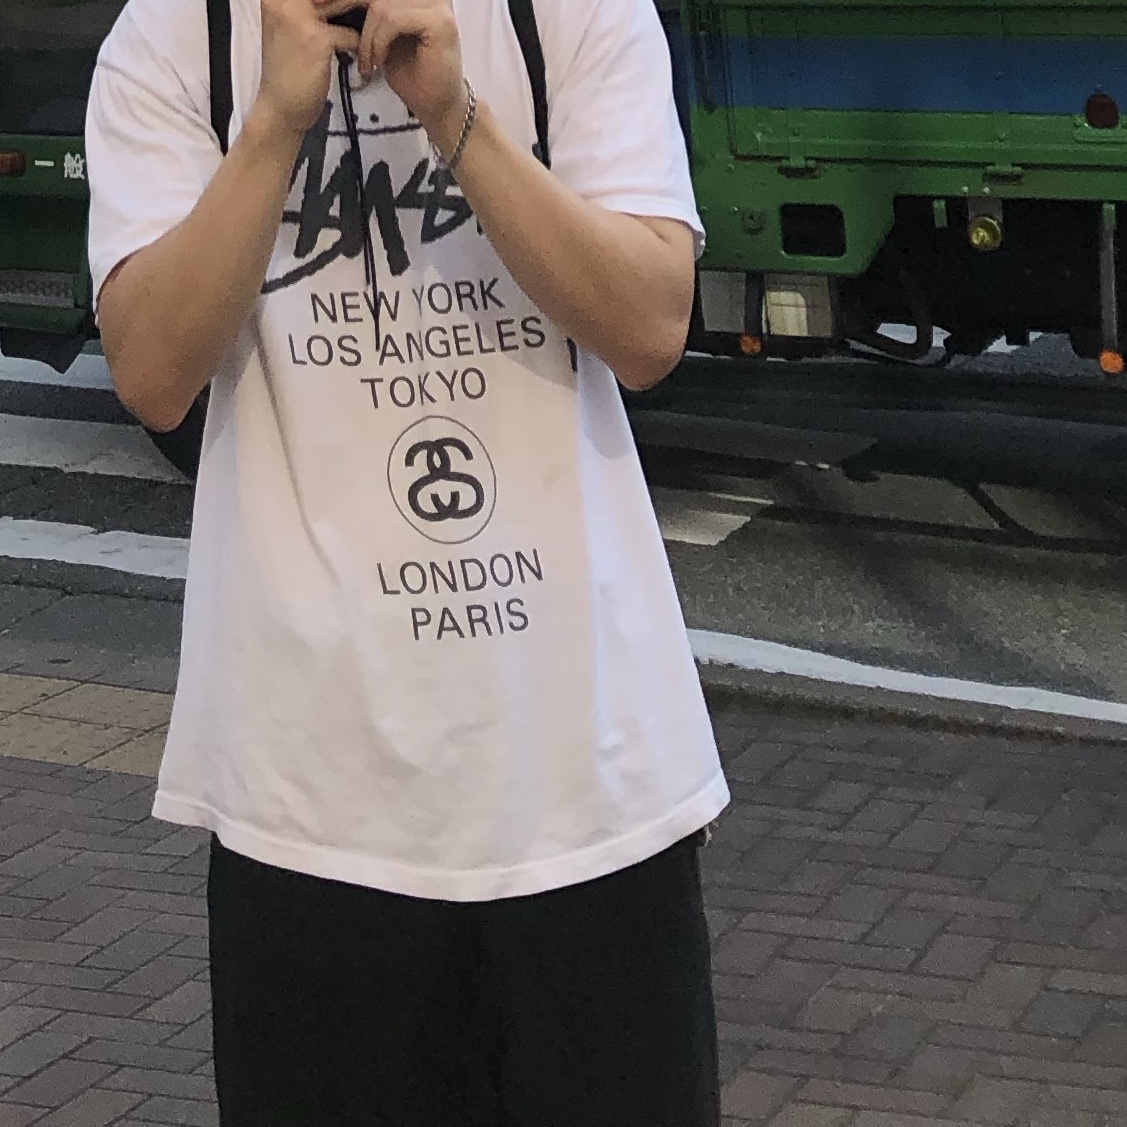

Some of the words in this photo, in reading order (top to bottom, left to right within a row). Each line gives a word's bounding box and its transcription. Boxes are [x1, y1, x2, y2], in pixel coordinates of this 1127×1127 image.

[310, 289, 401, 324] NEW
[412, 277, 506, 314] YORK
[287, 333, 362, 367] LOS
[378, 316, 546, 366] ANGELES
[360, 367, 486, 410] TOKYO
[377, 548, 544, 595] LONDON
[411, 598, 529, 641] PARIS
